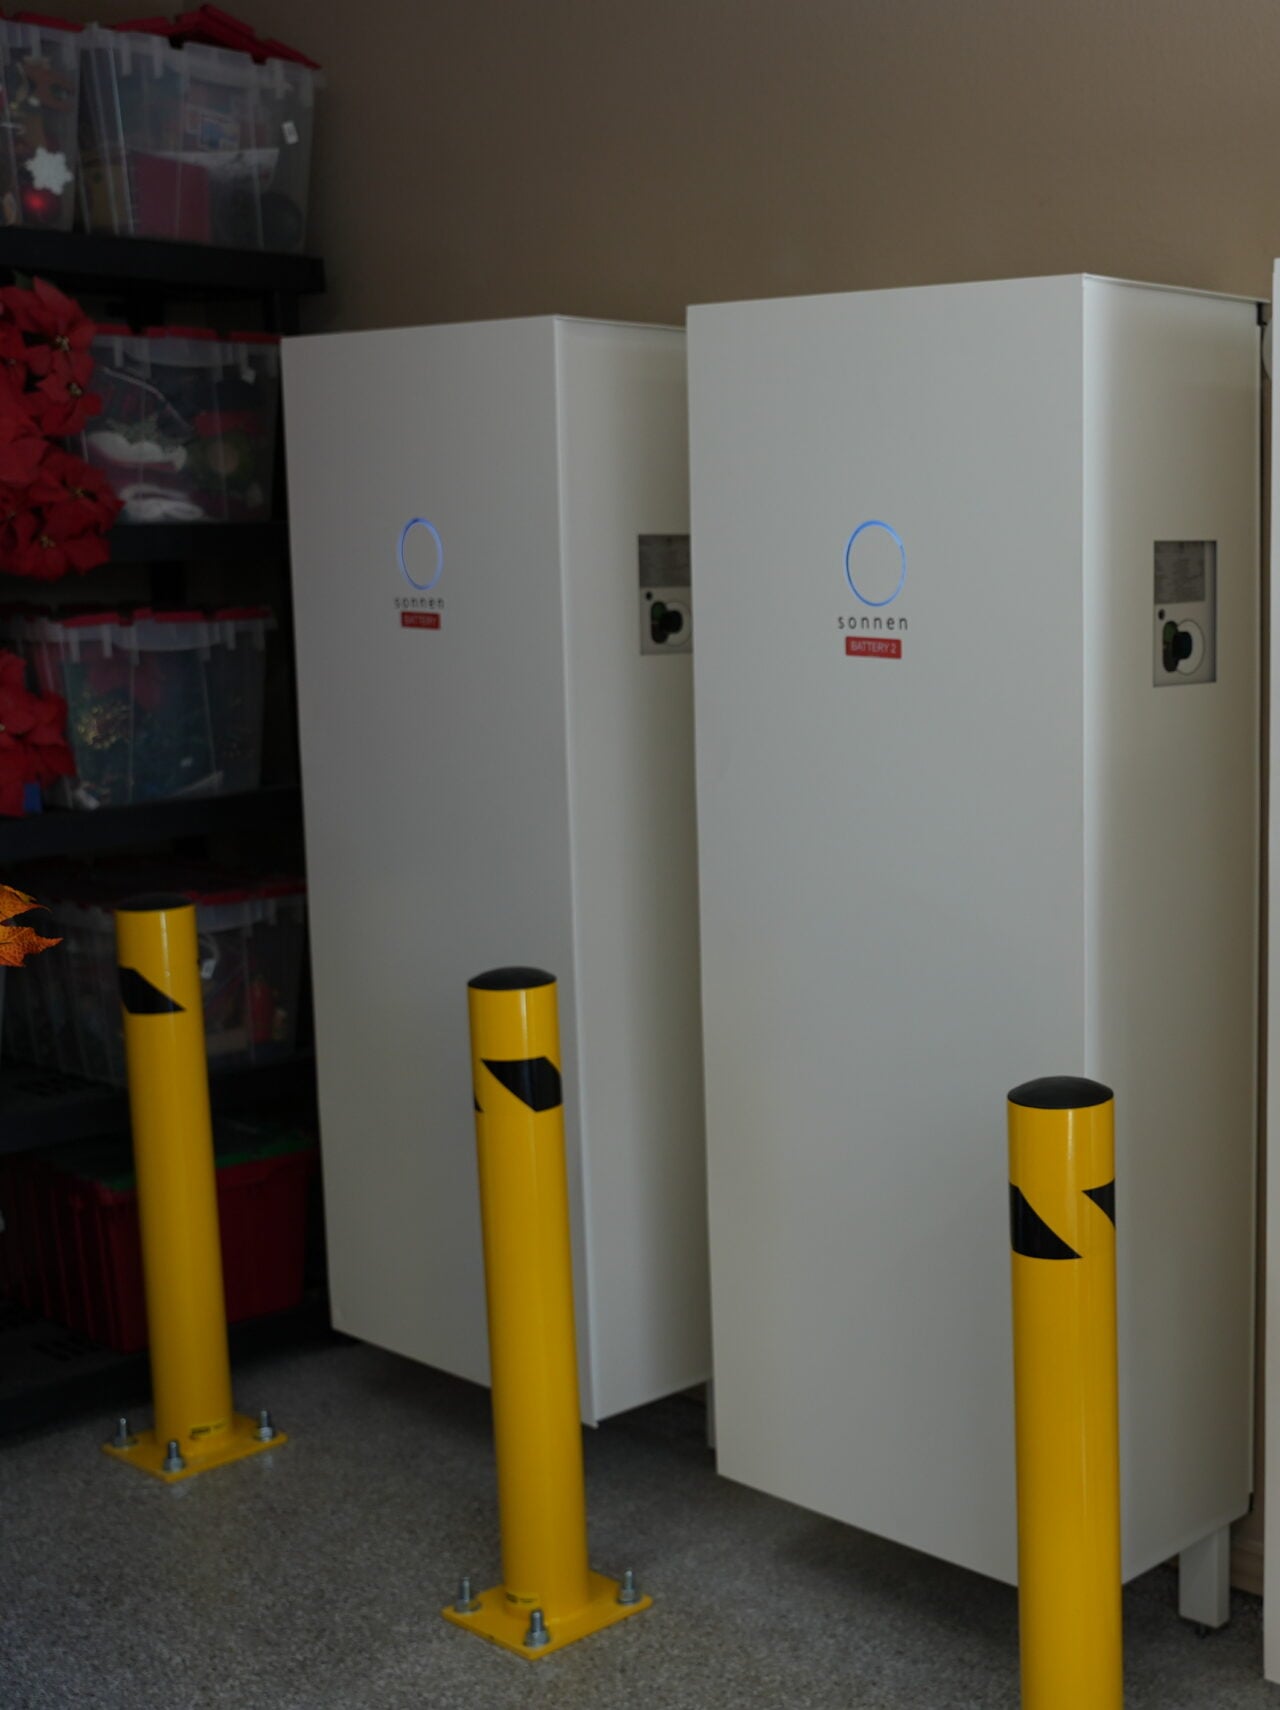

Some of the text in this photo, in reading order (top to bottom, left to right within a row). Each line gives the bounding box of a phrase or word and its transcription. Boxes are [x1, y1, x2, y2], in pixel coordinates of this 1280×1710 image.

[394, 597, 445, 609] sonnen
[837, 616, 908, 630] sonnen
[850, 640, 897, 654] BATTERY 2
